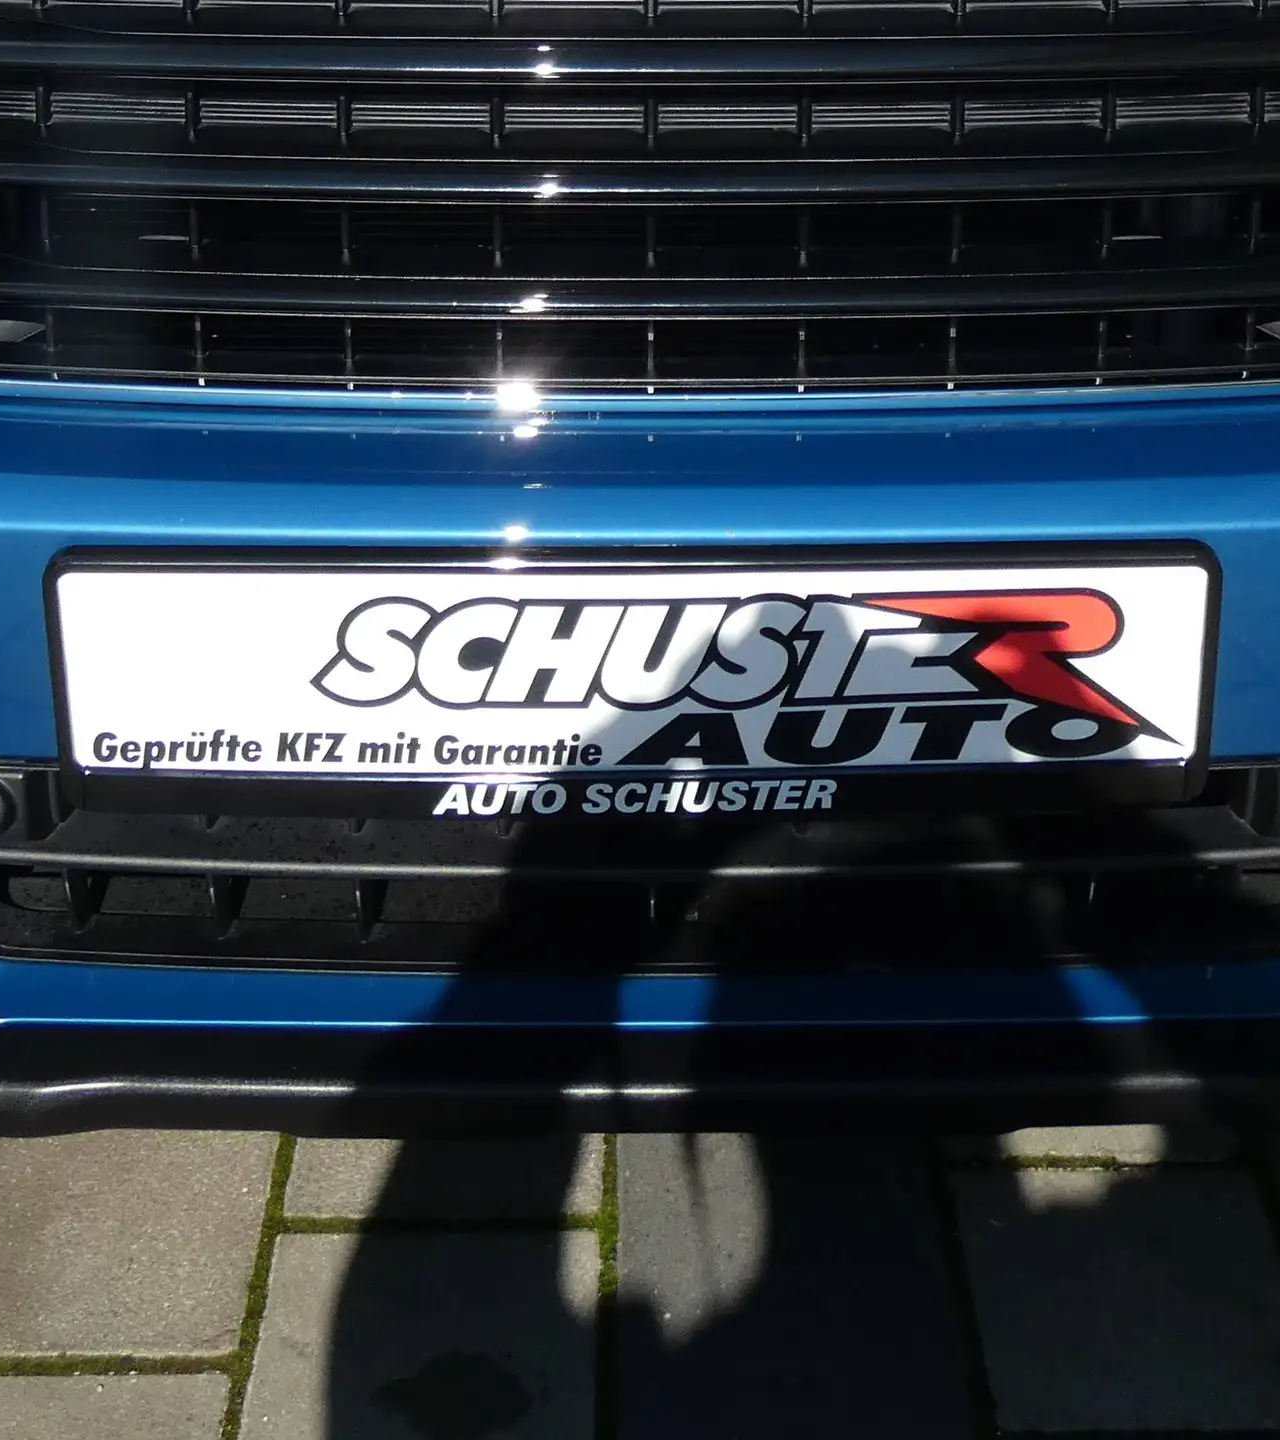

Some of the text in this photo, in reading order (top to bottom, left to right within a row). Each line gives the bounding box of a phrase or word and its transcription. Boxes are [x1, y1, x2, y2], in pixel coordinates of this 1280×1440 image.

[311, 588, 1183, 746] SCHUSTER
[92, 729, 603, 769] Geprüfte KFZ mit Garantie
[615, 703, 1140, 766] AUTO
[431, 779, 837, 816] AUTO SCHUSTER
